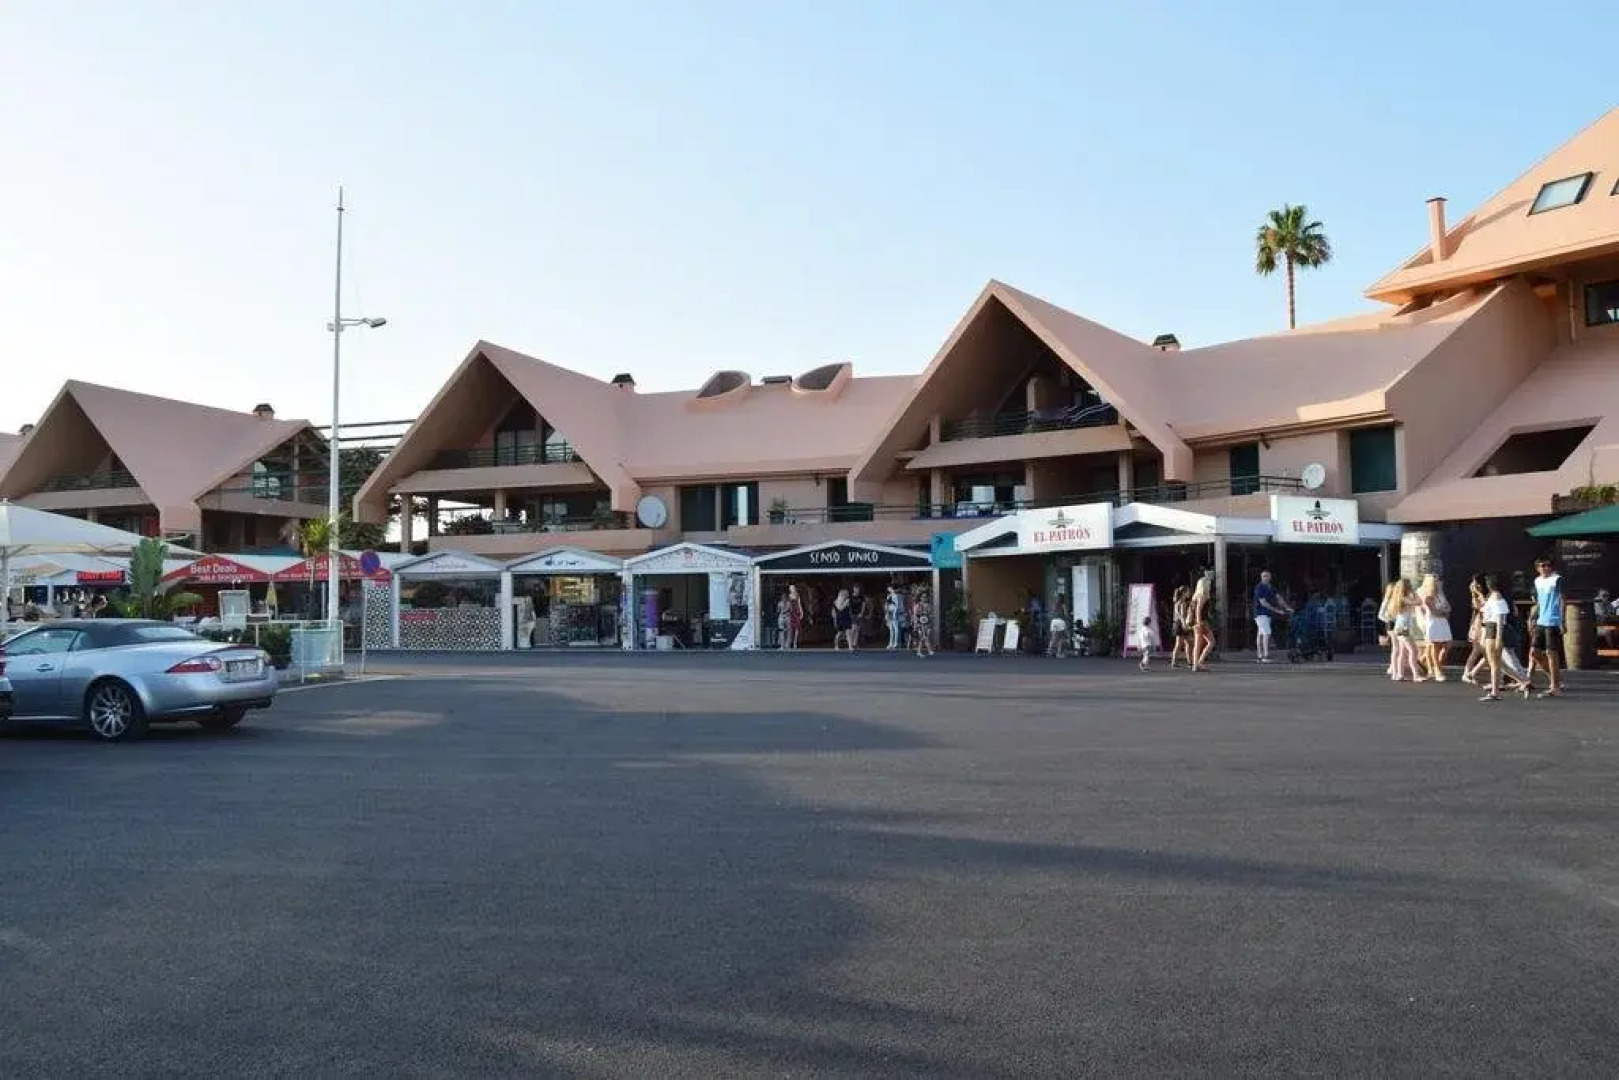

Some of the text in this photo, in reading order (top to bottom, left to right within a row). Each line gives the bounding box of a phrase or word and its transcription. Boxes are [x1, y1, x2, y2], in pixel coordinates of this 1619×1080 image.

[1292, 520, 1304, 532] EL
[1033, 530, 1047, 543] EL
[190, 564, 238, 574] Best Deals
